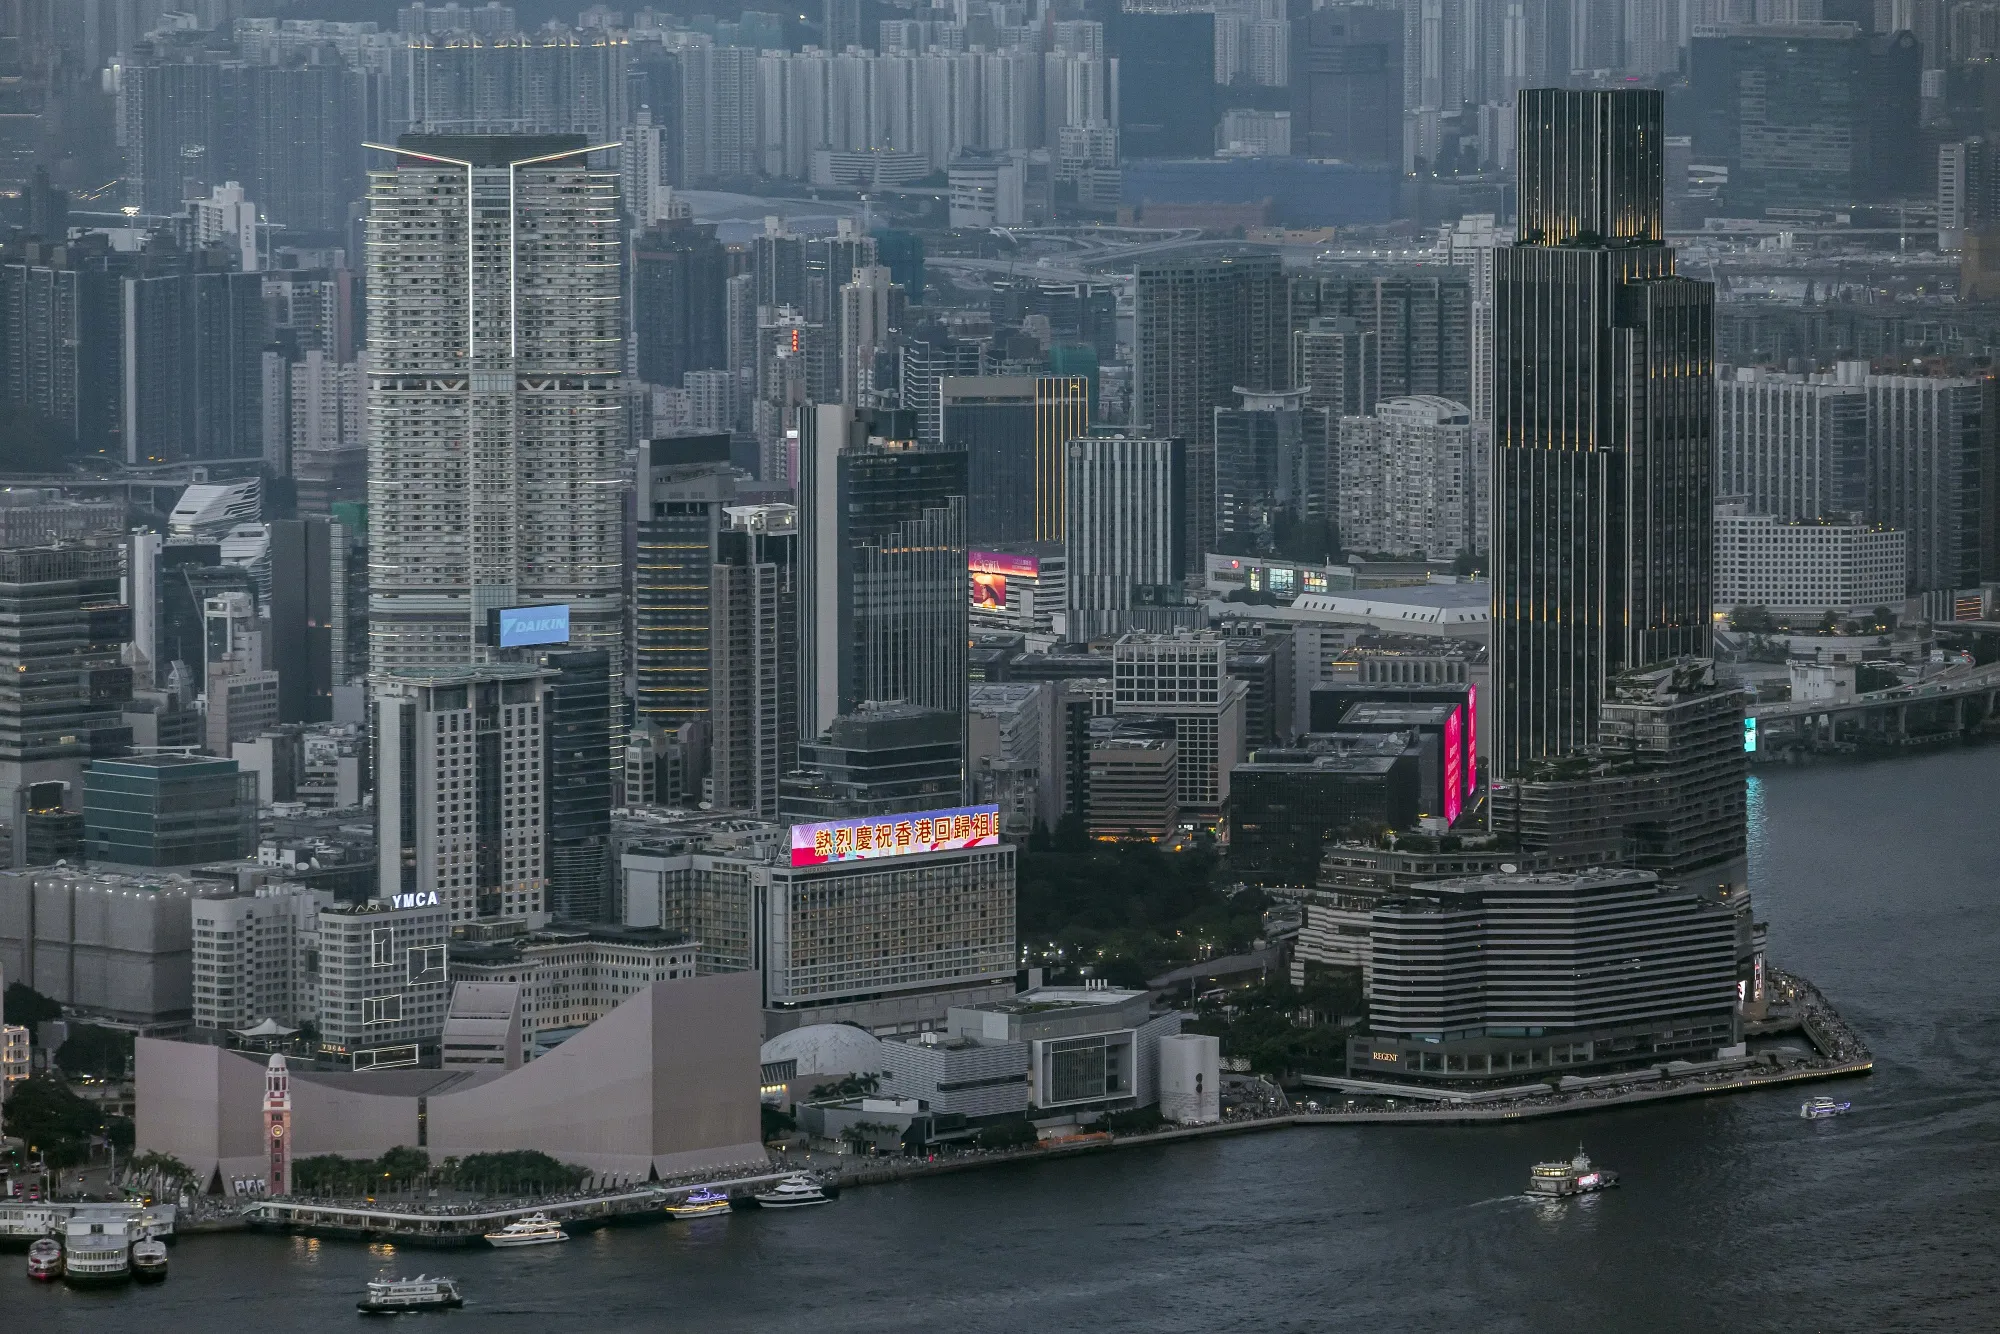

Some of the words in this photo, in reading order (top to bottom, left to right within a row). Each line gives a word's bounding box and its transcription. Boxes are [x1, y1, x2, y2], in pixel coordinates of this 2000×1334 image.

[515, 618, 566, 633] DAIKIN
[392, 890, 438, 909] YMCA
[1373, 1051, 1399, 1062] REGENT
